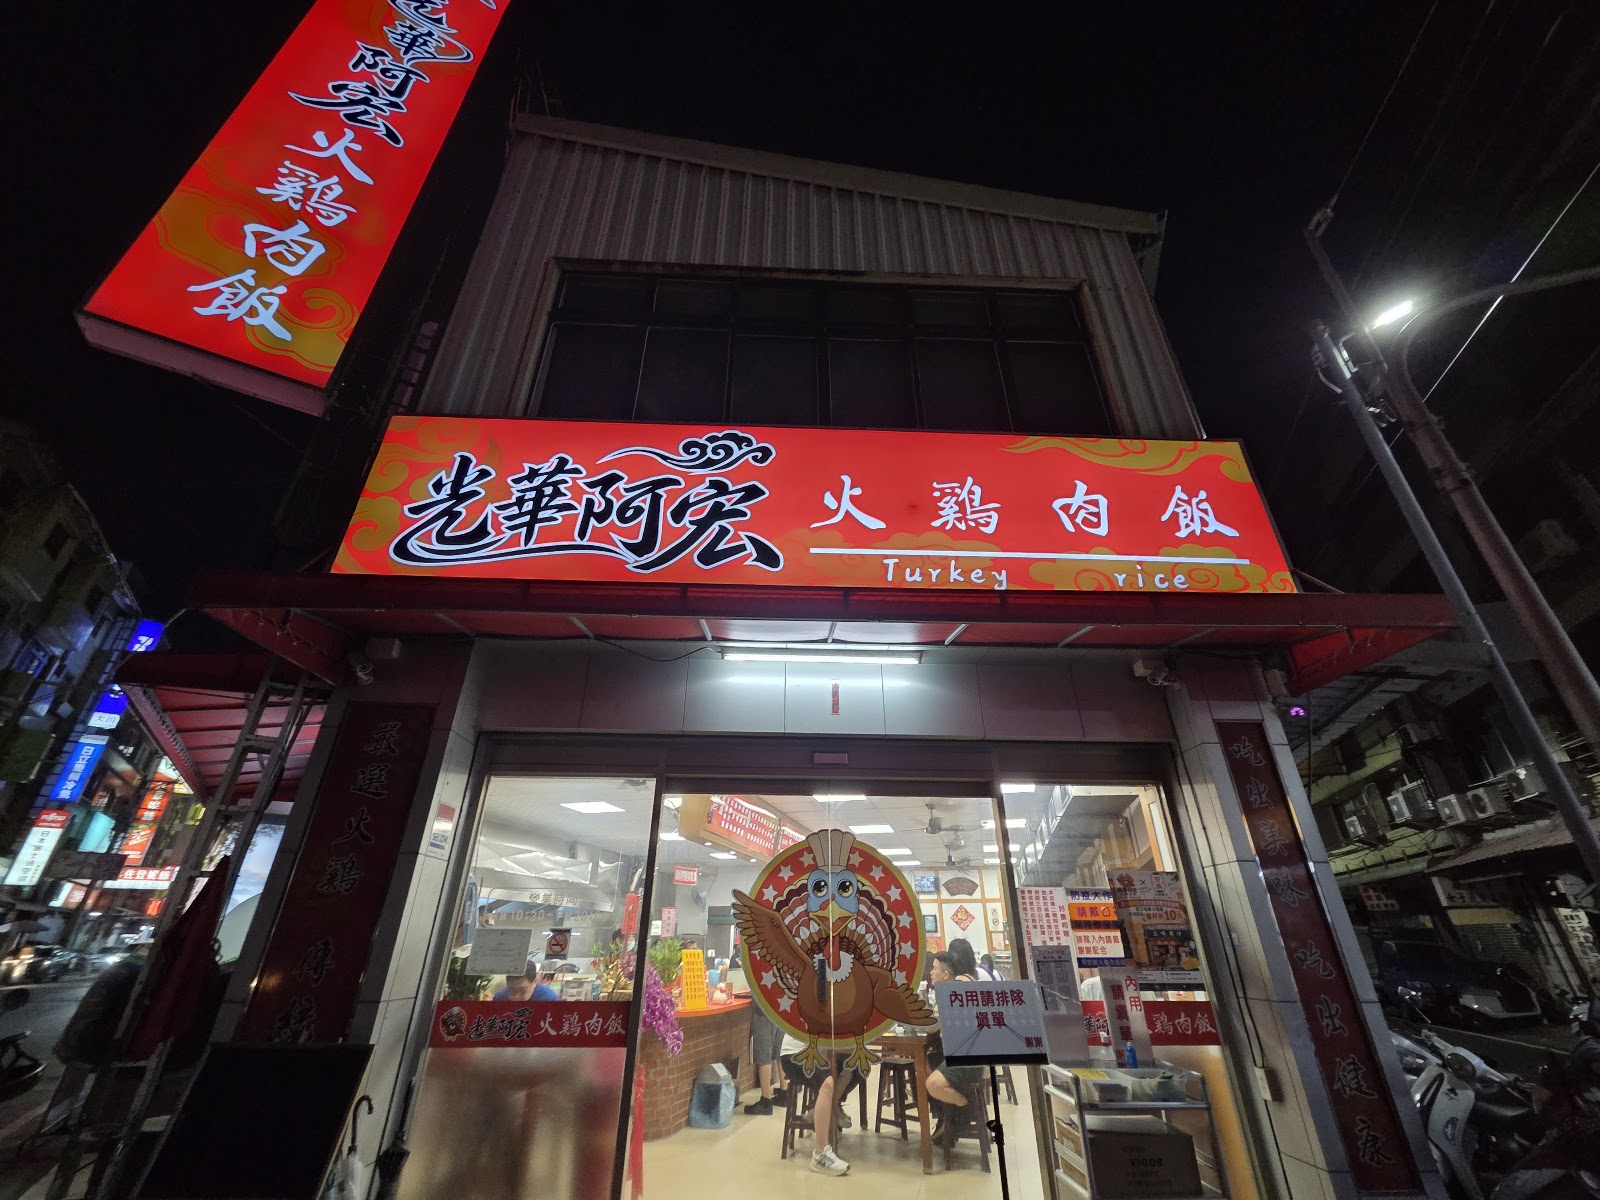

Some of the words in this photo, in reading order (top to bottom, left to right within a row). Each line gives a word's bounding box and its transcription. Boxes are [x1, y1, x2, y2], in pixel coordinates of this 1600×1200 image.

[390, 452, 784, 573] 光華阿宏
[883, 558, 1008, 591] Turkey
[1114, 566, 1190, 590] rice
[1229, 736, 1308, 907] 吃出美味
[949, 989, 1026, 1007] 內用請排隊
[1124, 975, 1143, 1012] 內用
[469, 1014, 532, 1041] 光華阿宏
[1294, 940, 1395, 1168] 吃出健康
